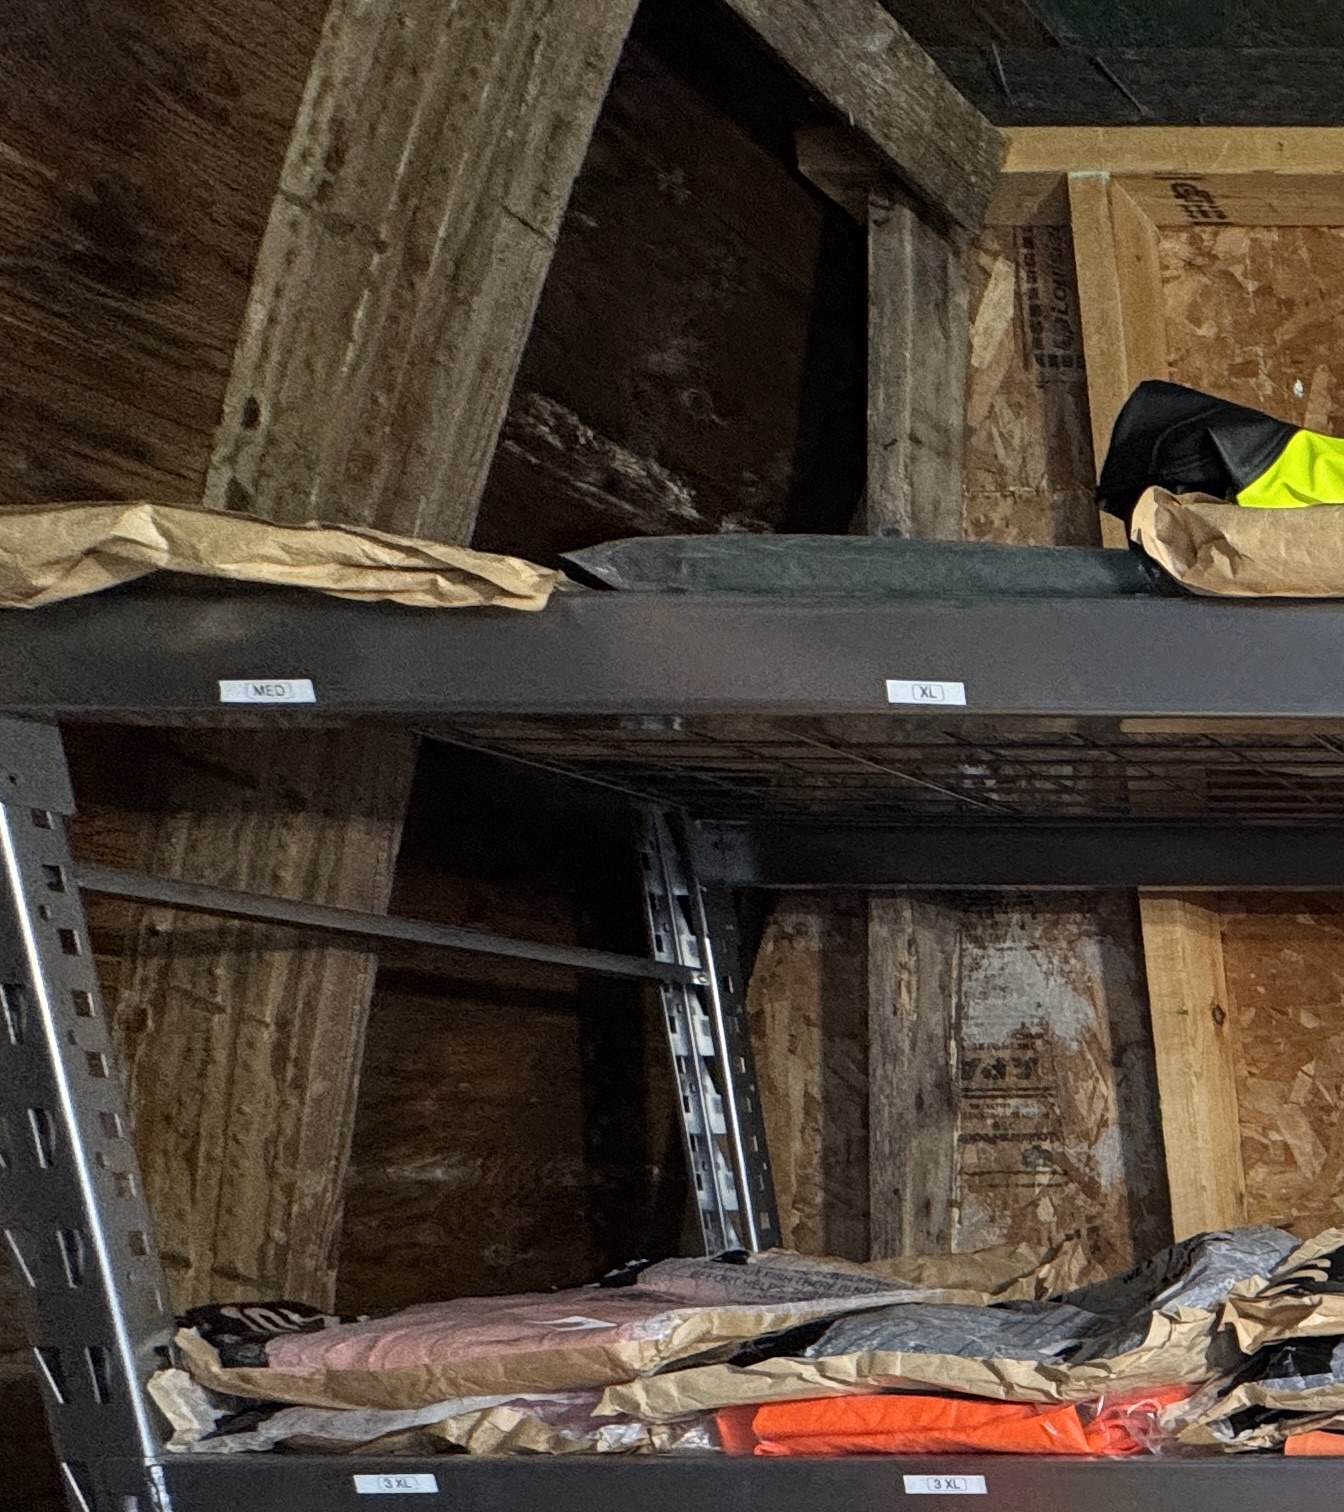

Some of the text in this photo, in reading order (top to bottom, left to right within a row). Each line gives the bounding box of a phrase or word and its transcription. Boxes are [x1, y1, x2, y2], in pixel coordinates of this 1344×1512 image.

[252, 684, 287, 697] MED
[920, 686, 938, 700] XL
[383, 1478, 412, 1489] 3 XL
[934, 1479, 961, 1490] 3 XL
